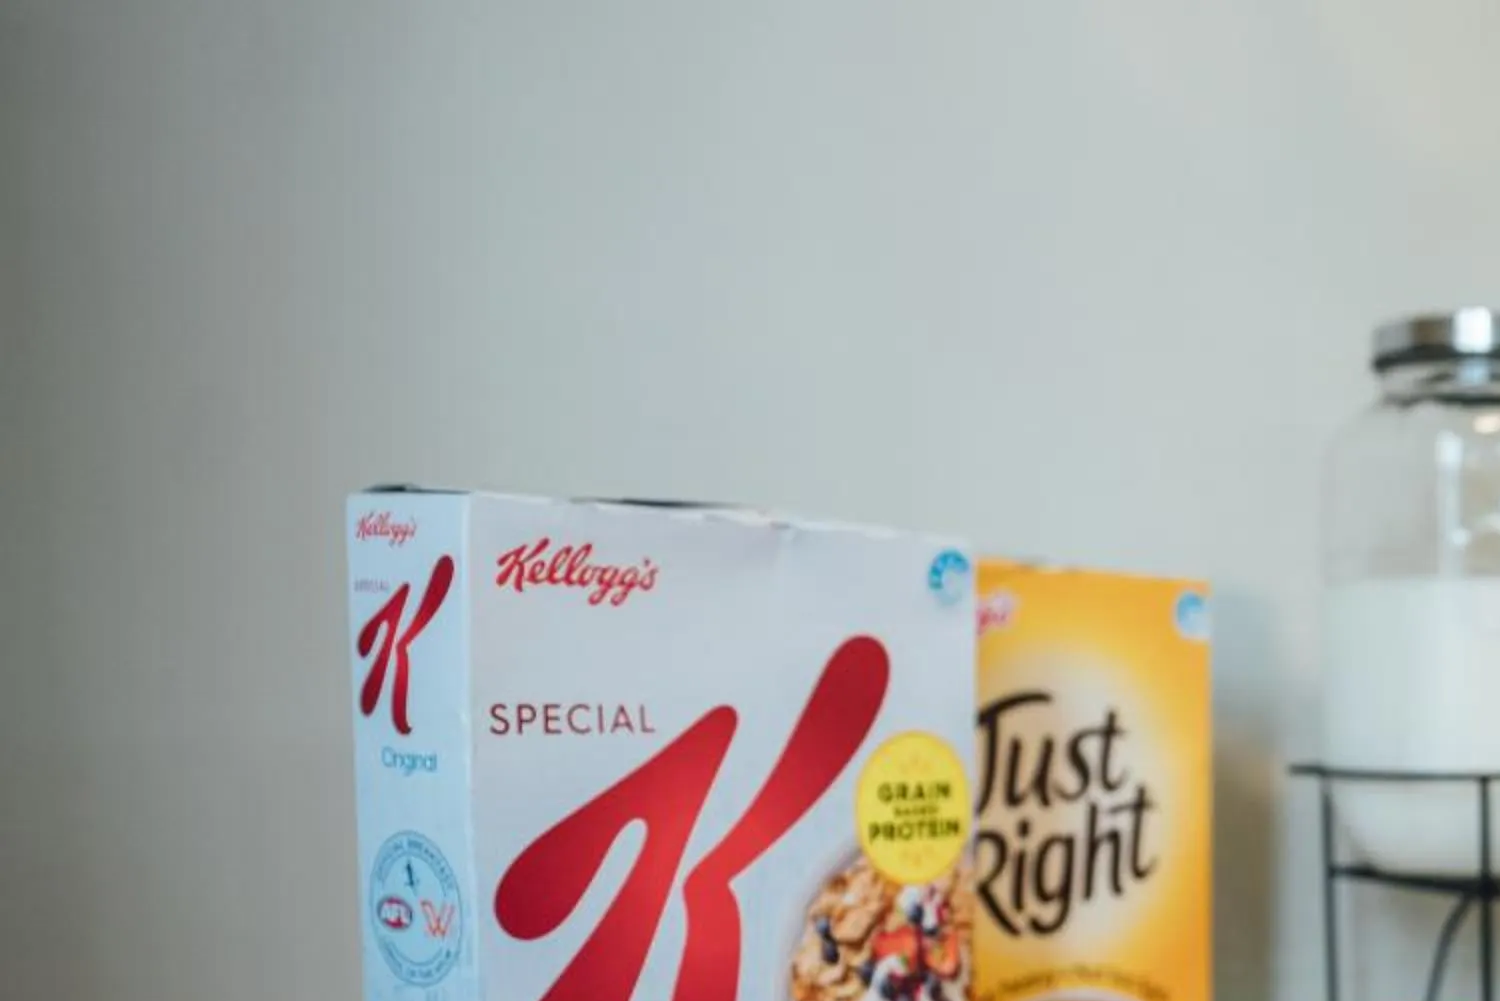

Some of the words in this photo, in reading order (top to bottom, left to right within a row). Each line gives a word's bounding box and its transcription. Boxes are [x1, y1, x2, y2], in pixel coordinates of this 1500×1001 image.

[496, 537, 660, 606] Kellogg's
[357, 555, 455, 736] K
[489, 703, 656, 735] SPECIAL
[976, 690, 1130, 817] Just
[876, 781, 952, 804] GRAIN
[867, 818, 960, 844] PROTEIN
[975, 784, 1158, 938] Right
